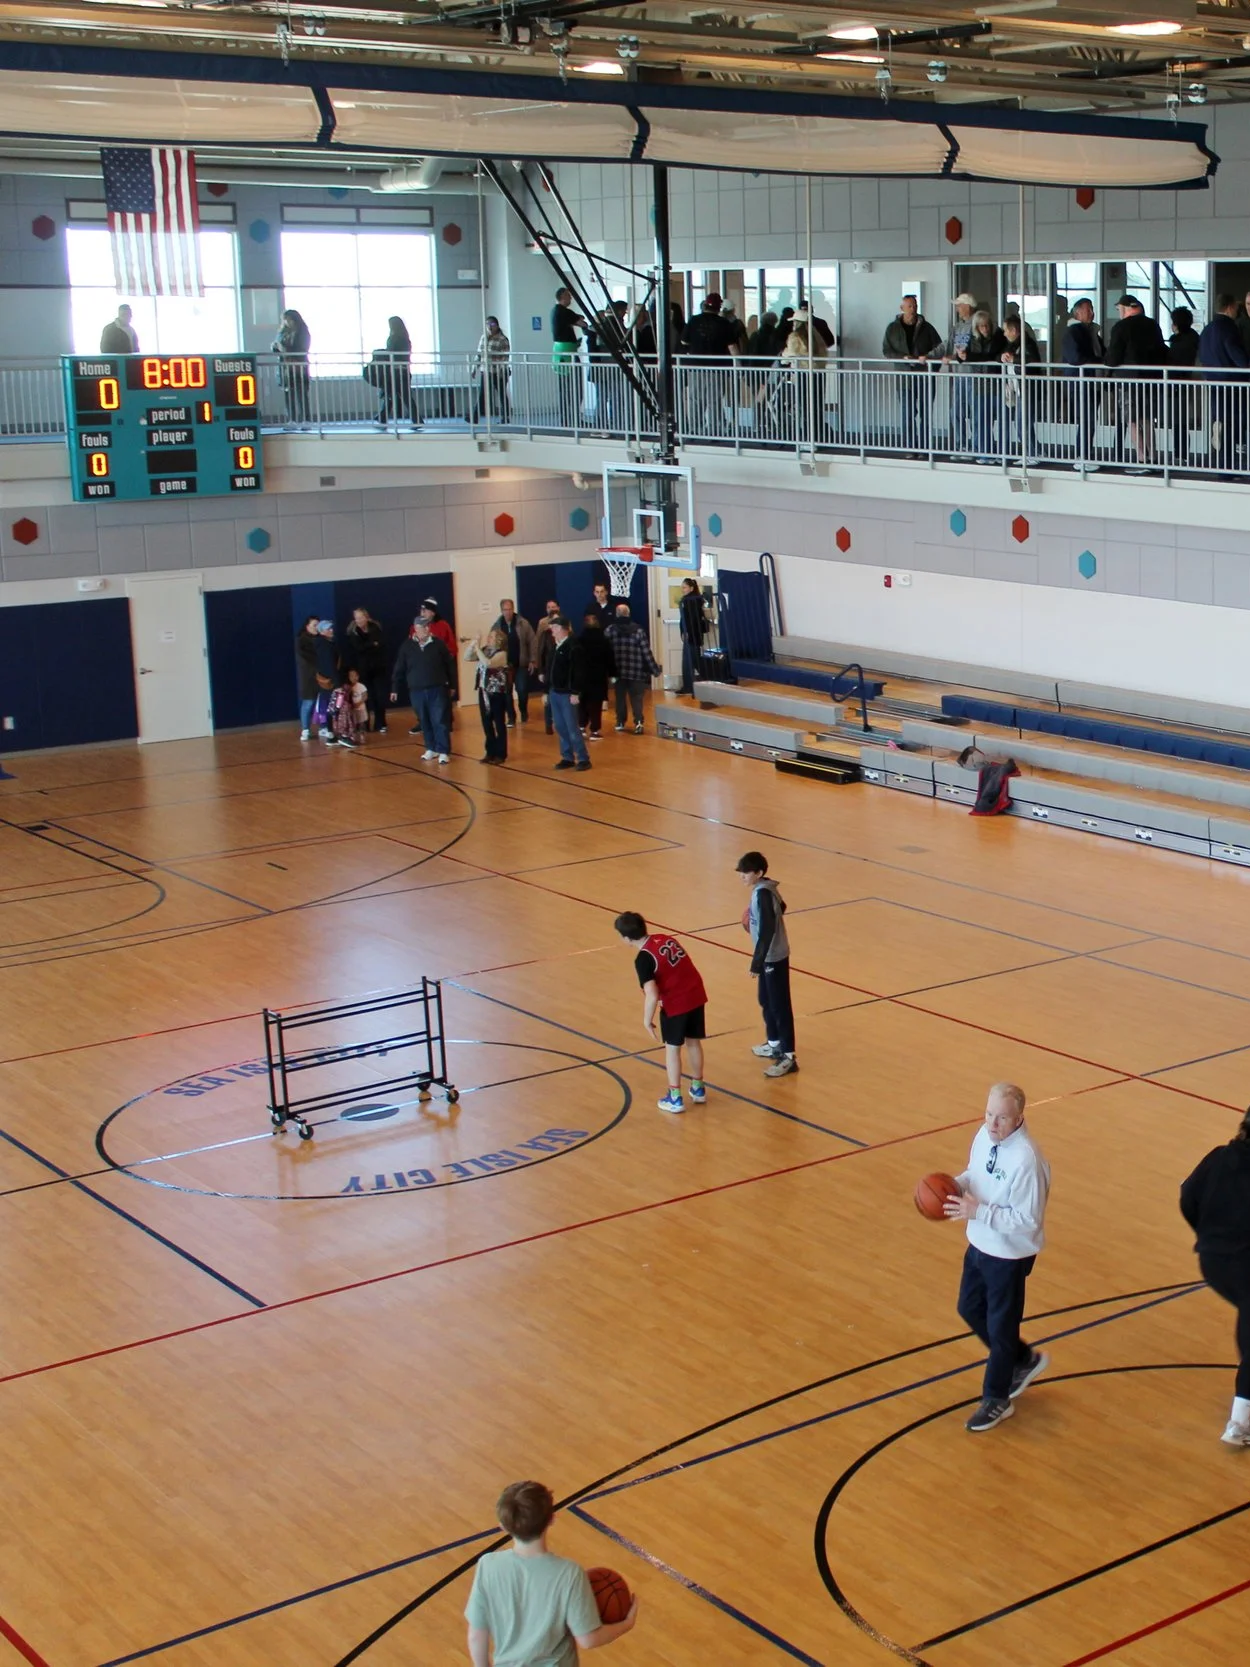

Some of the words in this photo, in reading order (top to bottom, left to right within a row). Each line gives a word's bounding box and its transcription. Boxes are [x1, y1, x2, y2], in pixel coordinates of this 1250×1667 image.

[79, 361, 111, 375] Home
[143, 357, 206, 389] 8:00
[214, 359, 252, 373] Guests
[98, 378, 119, 410] 0
[236, 375, 257, 405] 0
[152, 407, 185, 421] period
[203, 402, 211, 422] 1
[82, 433, 109, 447] fouls
[152, 430, 188, 445] player
[229, 428, 255, 441] fouls
[91, 453, 107, 476] 0
[238, 446, 253, 469] 0
[88, 483, 110, 495] won
[159, 479, 187, 494] game
[235, 476, 256, 488] won
[659, 939, 686, 967] 23
[163, 1068, 236, 1098] SEA
[515, 1128, 590, 1152] SEA
[441, 1149, 533, 1179] ISLE
[340, 1168, 437, 1194] CITY
